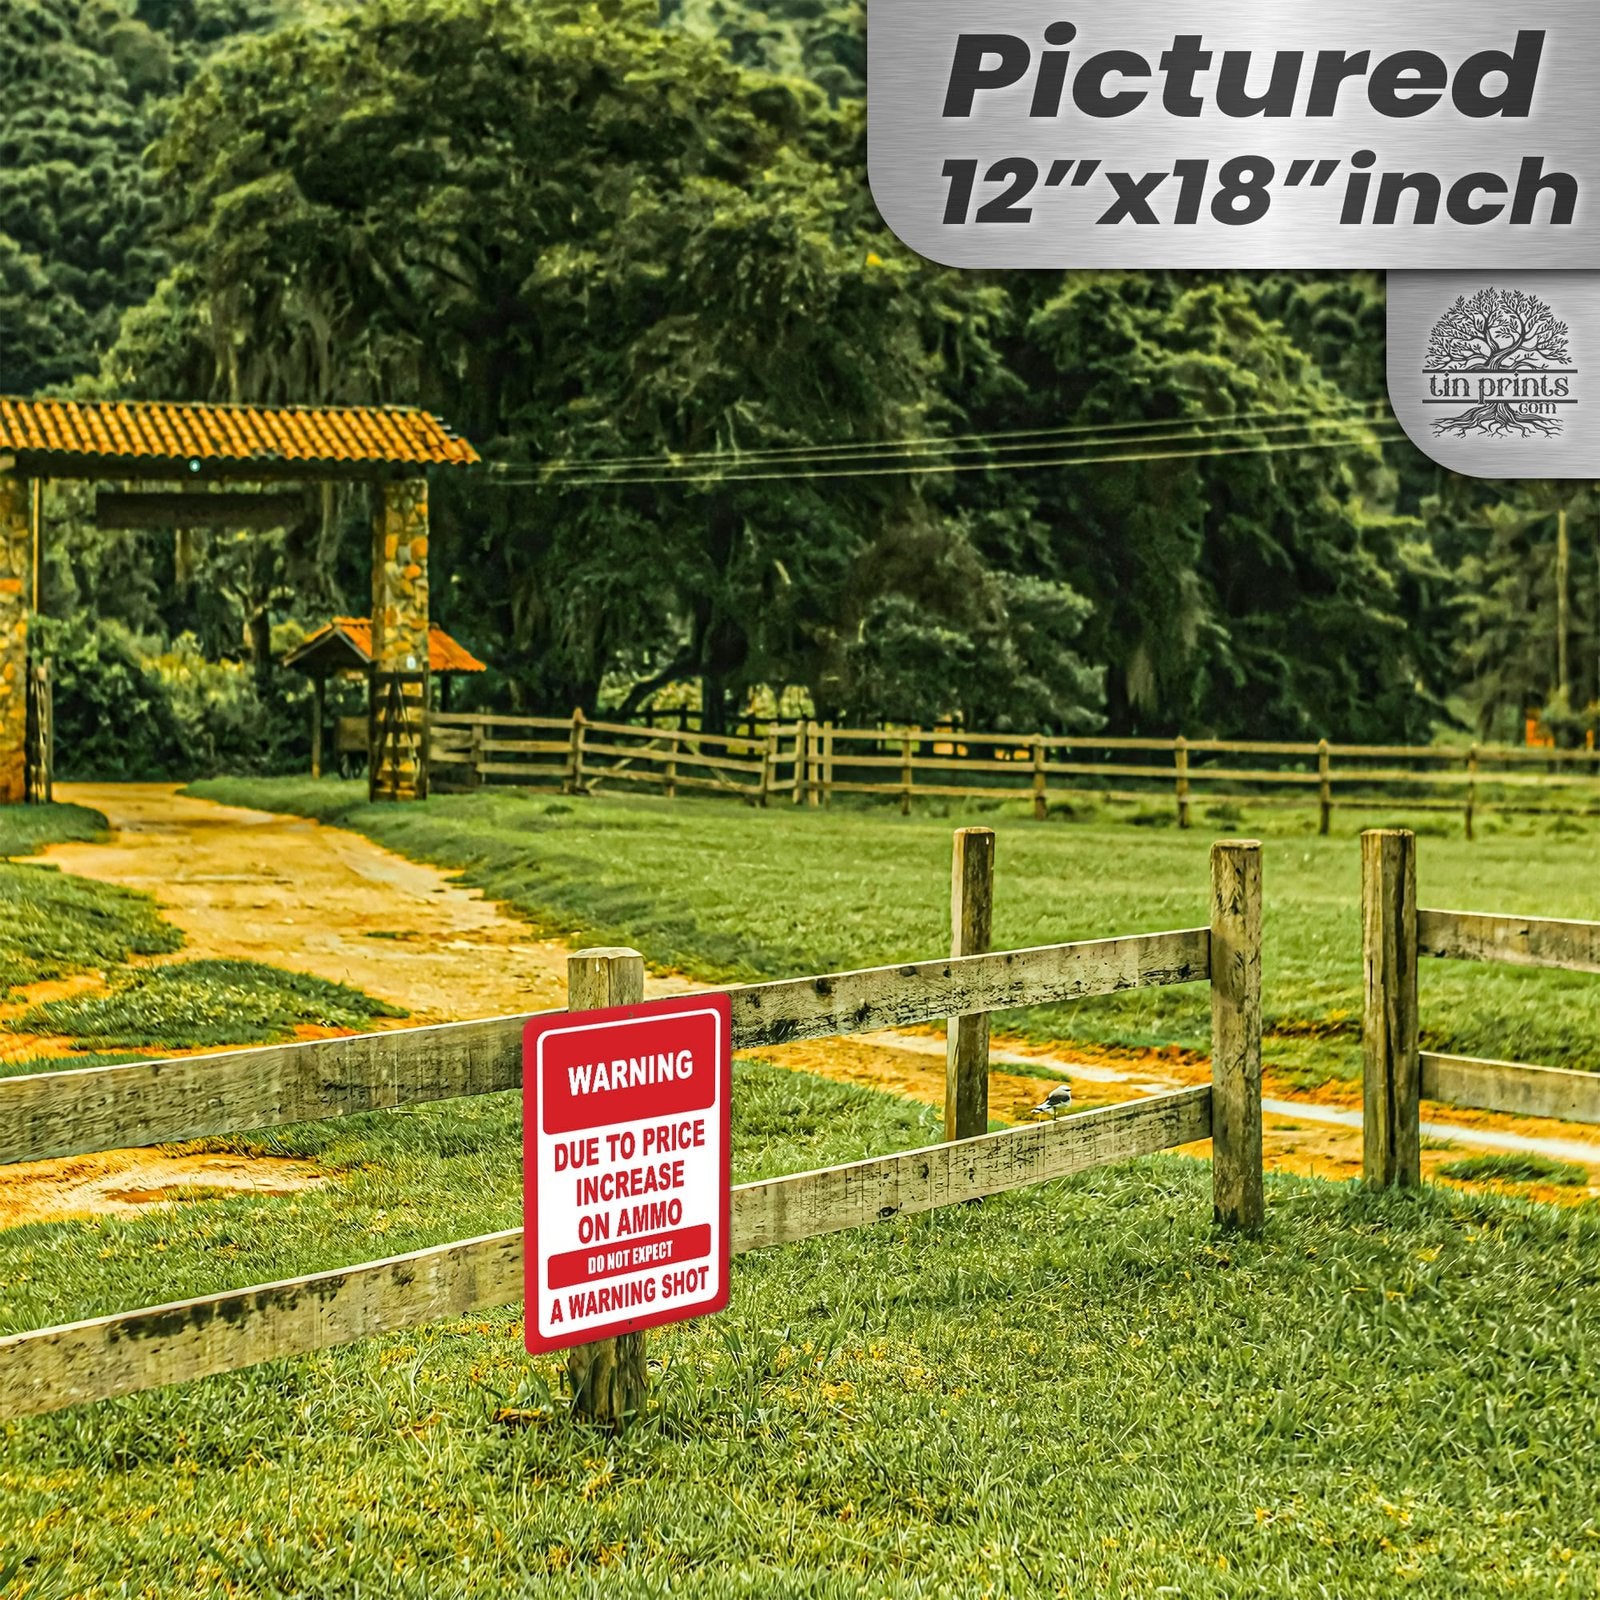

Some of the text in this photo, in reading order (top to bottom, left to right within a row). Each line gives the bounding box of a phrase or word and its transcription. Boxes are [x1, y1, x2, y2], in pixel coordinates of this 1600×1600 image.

[568, 1049, 693, 1096] WARNING
[554, 1119, 705, 1172] DUE TO PRICE
[576, 1160, 685, 1207] INCREASE
[578, 1198, 683, 1244] ON AMMO
[587, 1240, 673, 1274] DO NOT EXPECT
[550, 1265, 709, 1325] A WARNING SHOT
